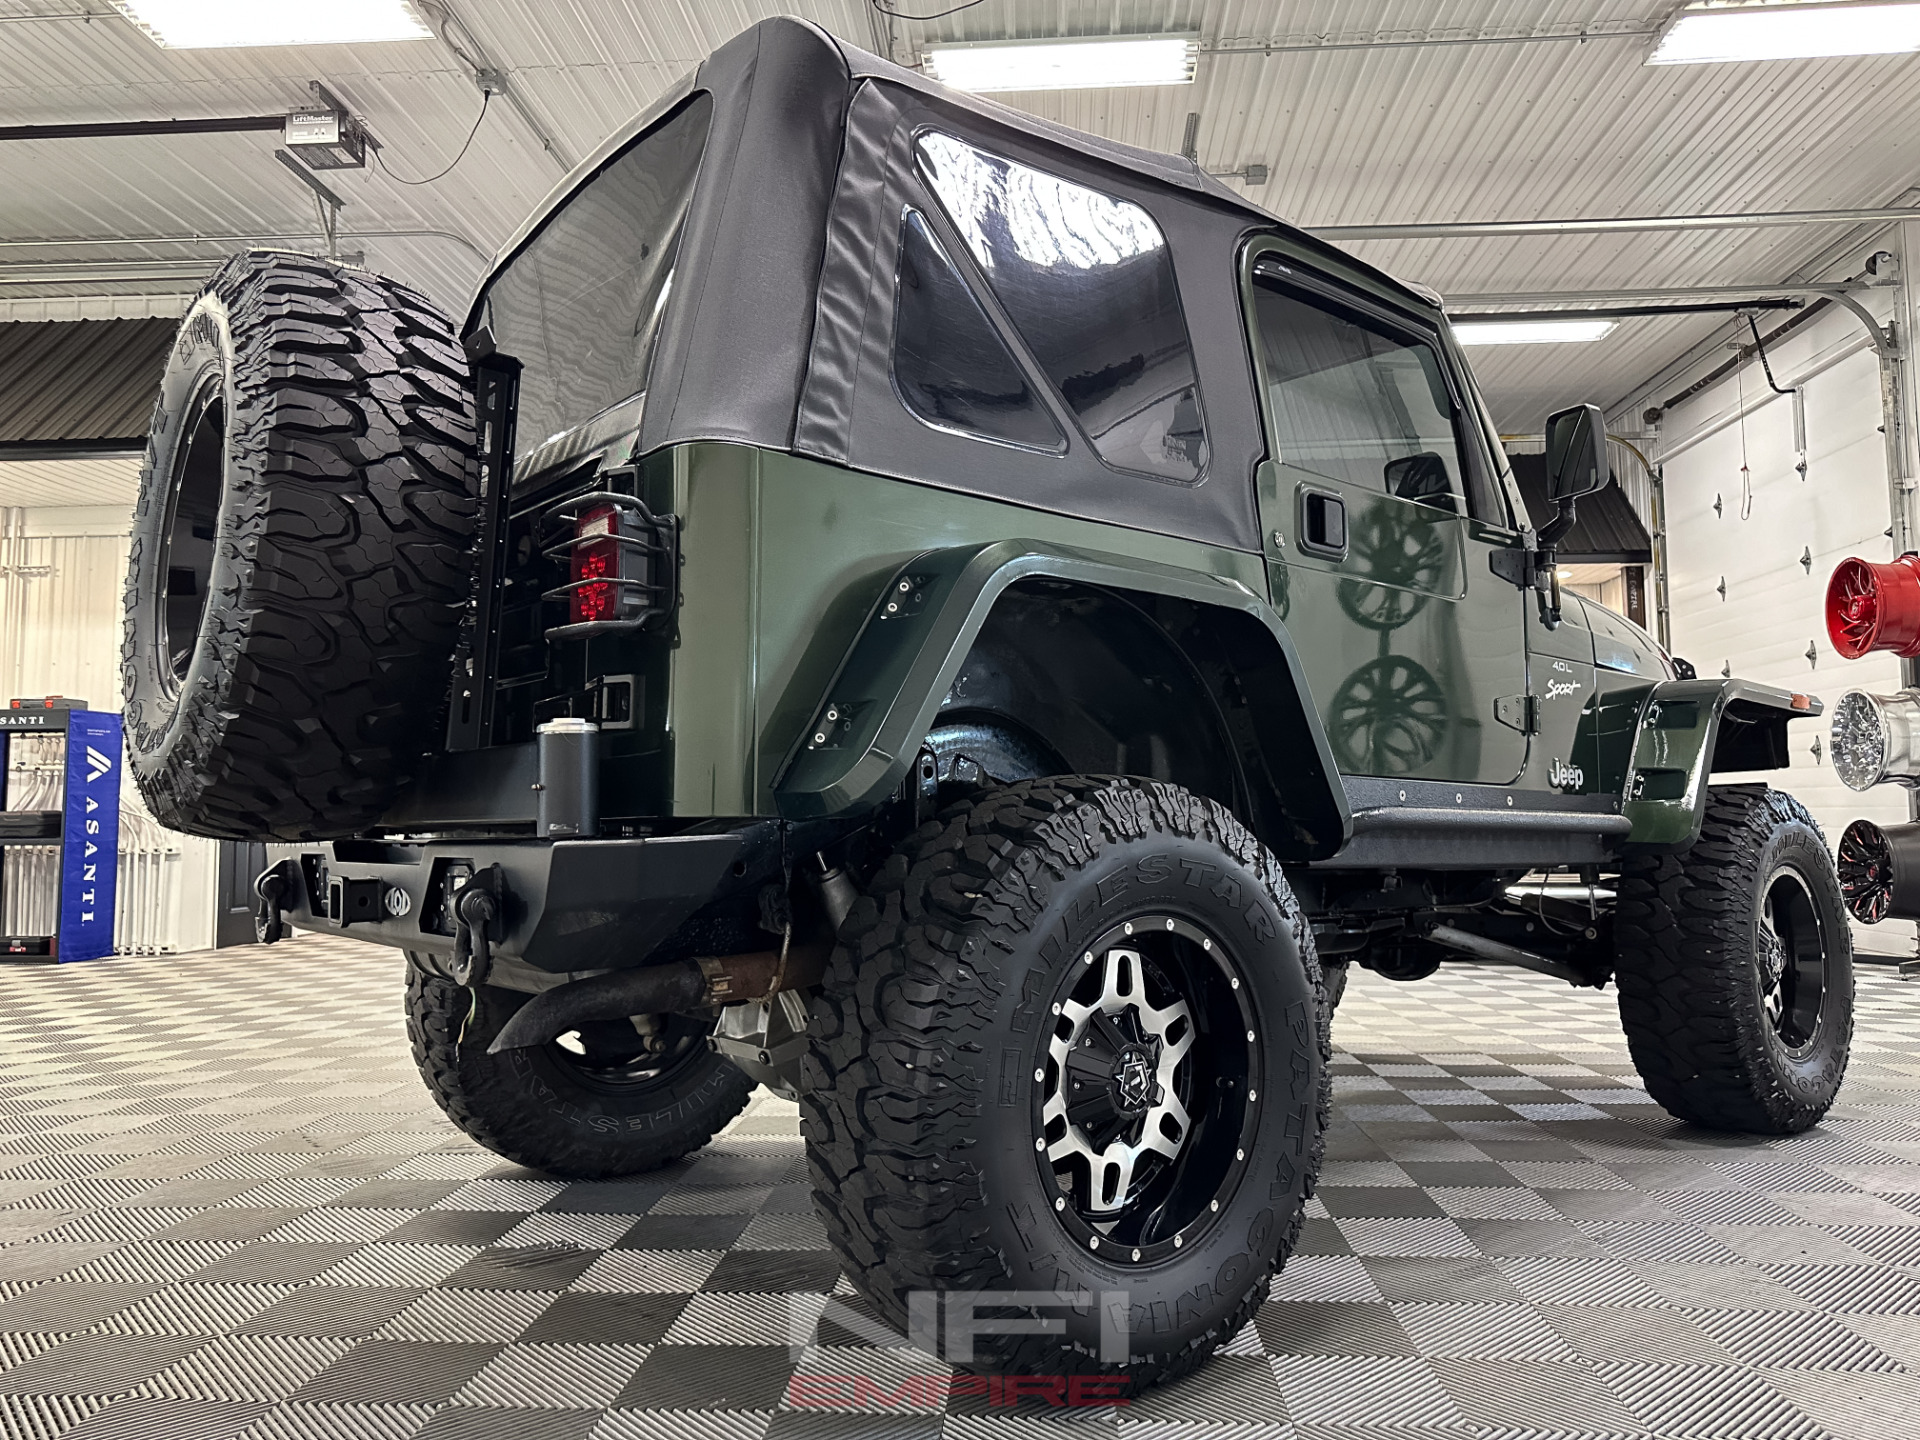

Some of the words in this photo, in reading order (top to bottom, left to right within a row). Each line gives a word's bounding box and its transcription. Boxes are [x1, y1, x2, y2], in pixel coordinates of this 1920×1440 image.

[1548, 757, 1584, 791] Jeep
[81, 796, 99, 923] ASANTI
[1010, 853, 1278, 1034] MILESTAR
[1107, 1001, 1311, 1334] PATAGONIA
